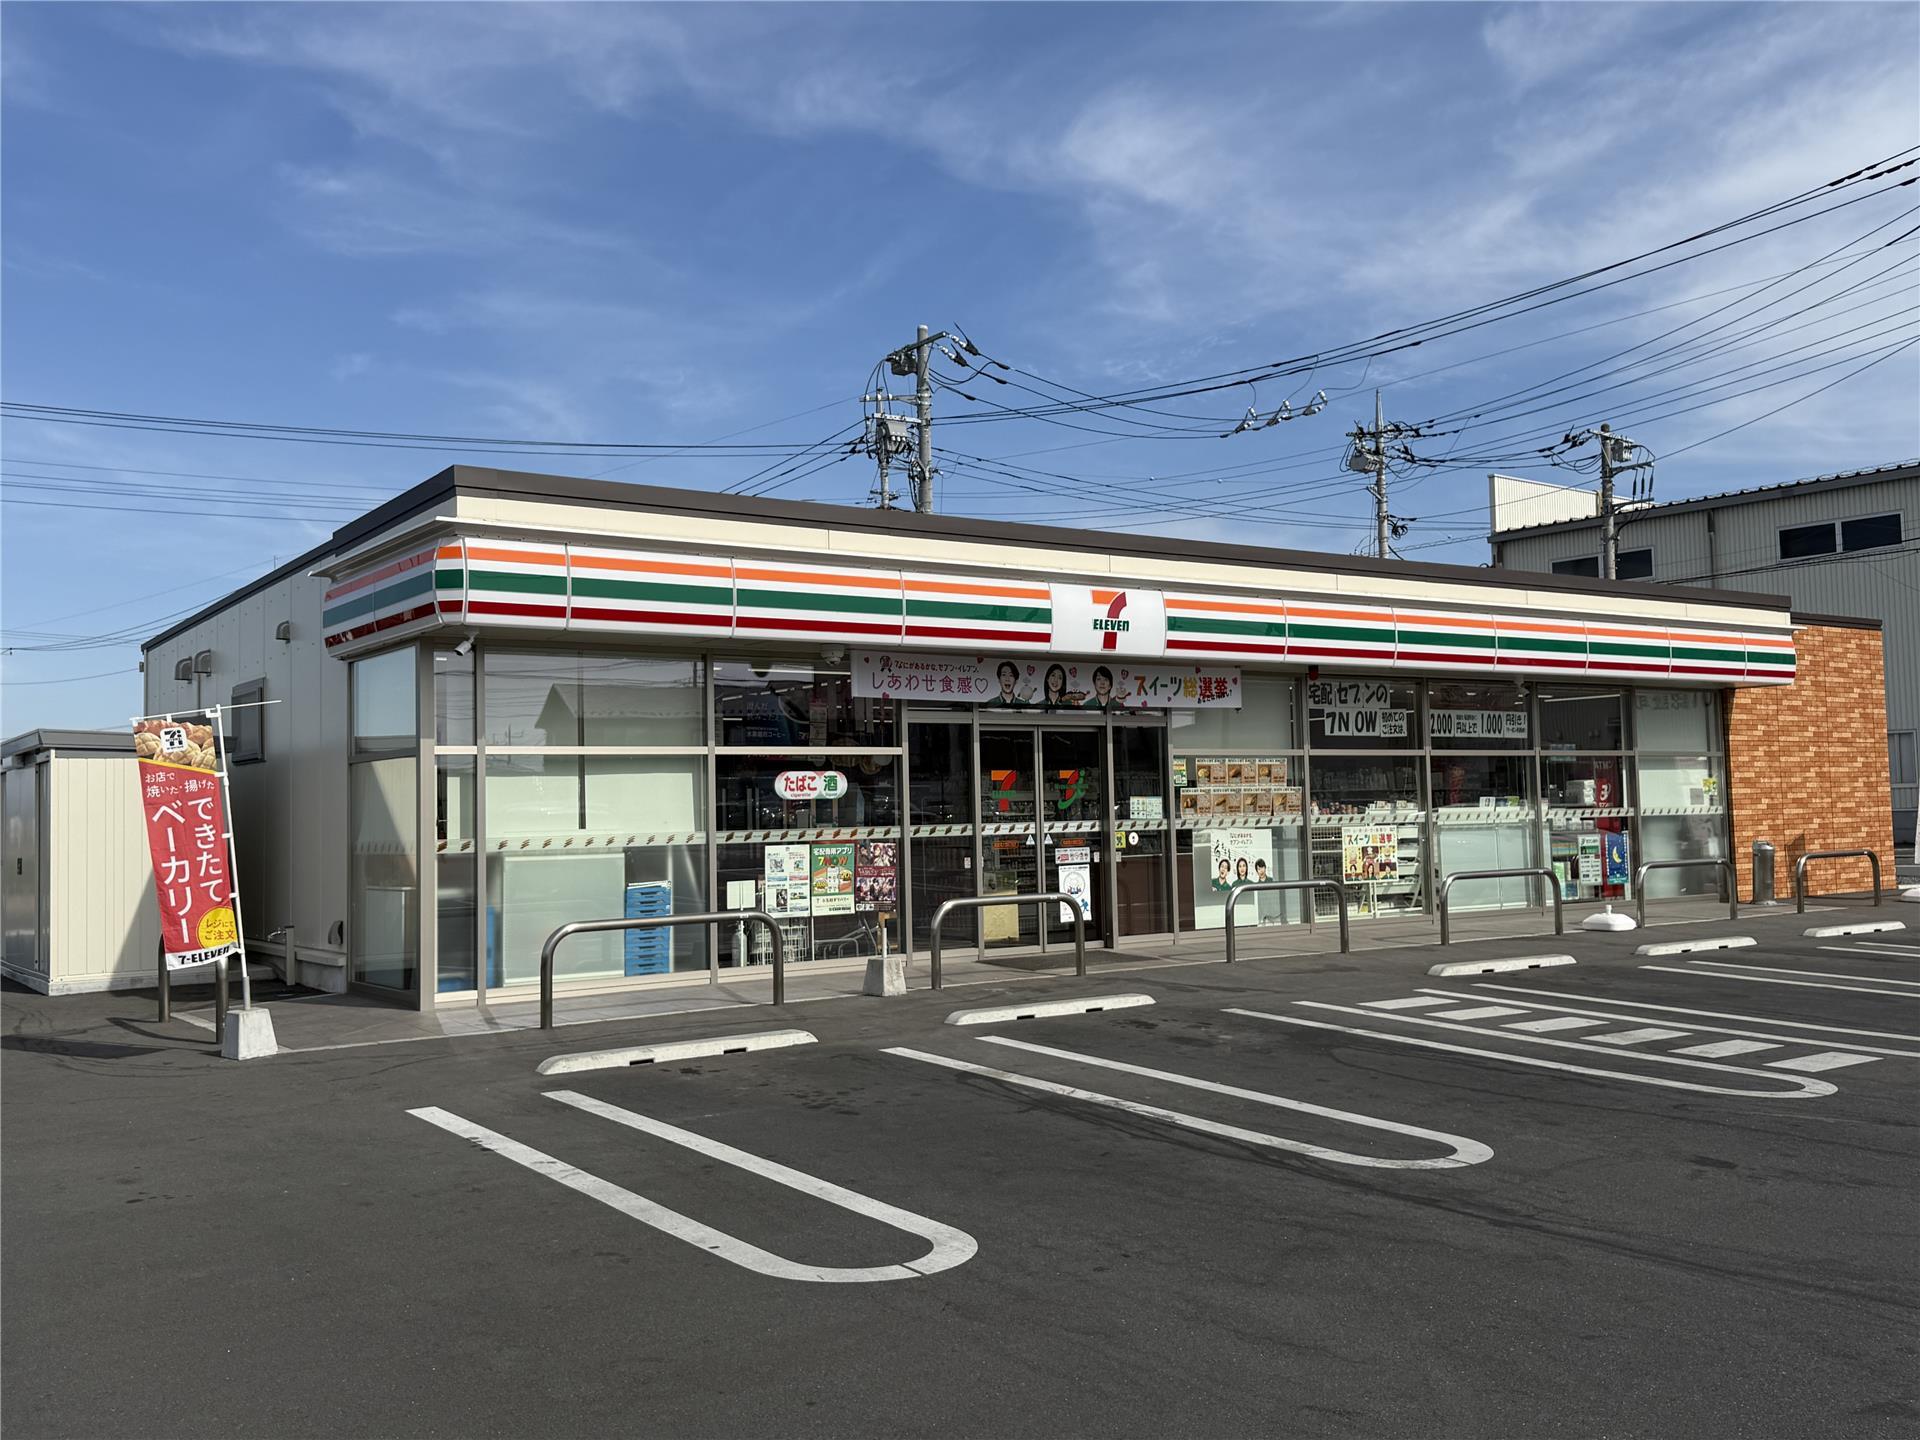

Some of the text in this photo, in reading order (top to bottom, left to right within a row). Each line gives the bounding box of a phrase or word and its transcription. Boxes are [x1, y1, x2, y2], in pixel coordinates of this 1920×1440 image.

[872, 671, 973, 694] しあわせ食感
[1133, 675, 1228, 699] スイーツ総選挙
[145, 772, 175, 784] お店で
[784, 775, 838, 792] たばこ 酒
[187, 796, 223, 903] できたて
[152, 799, 193, 944] ベーカリー
[205, 929, 235, 941] ご注文
